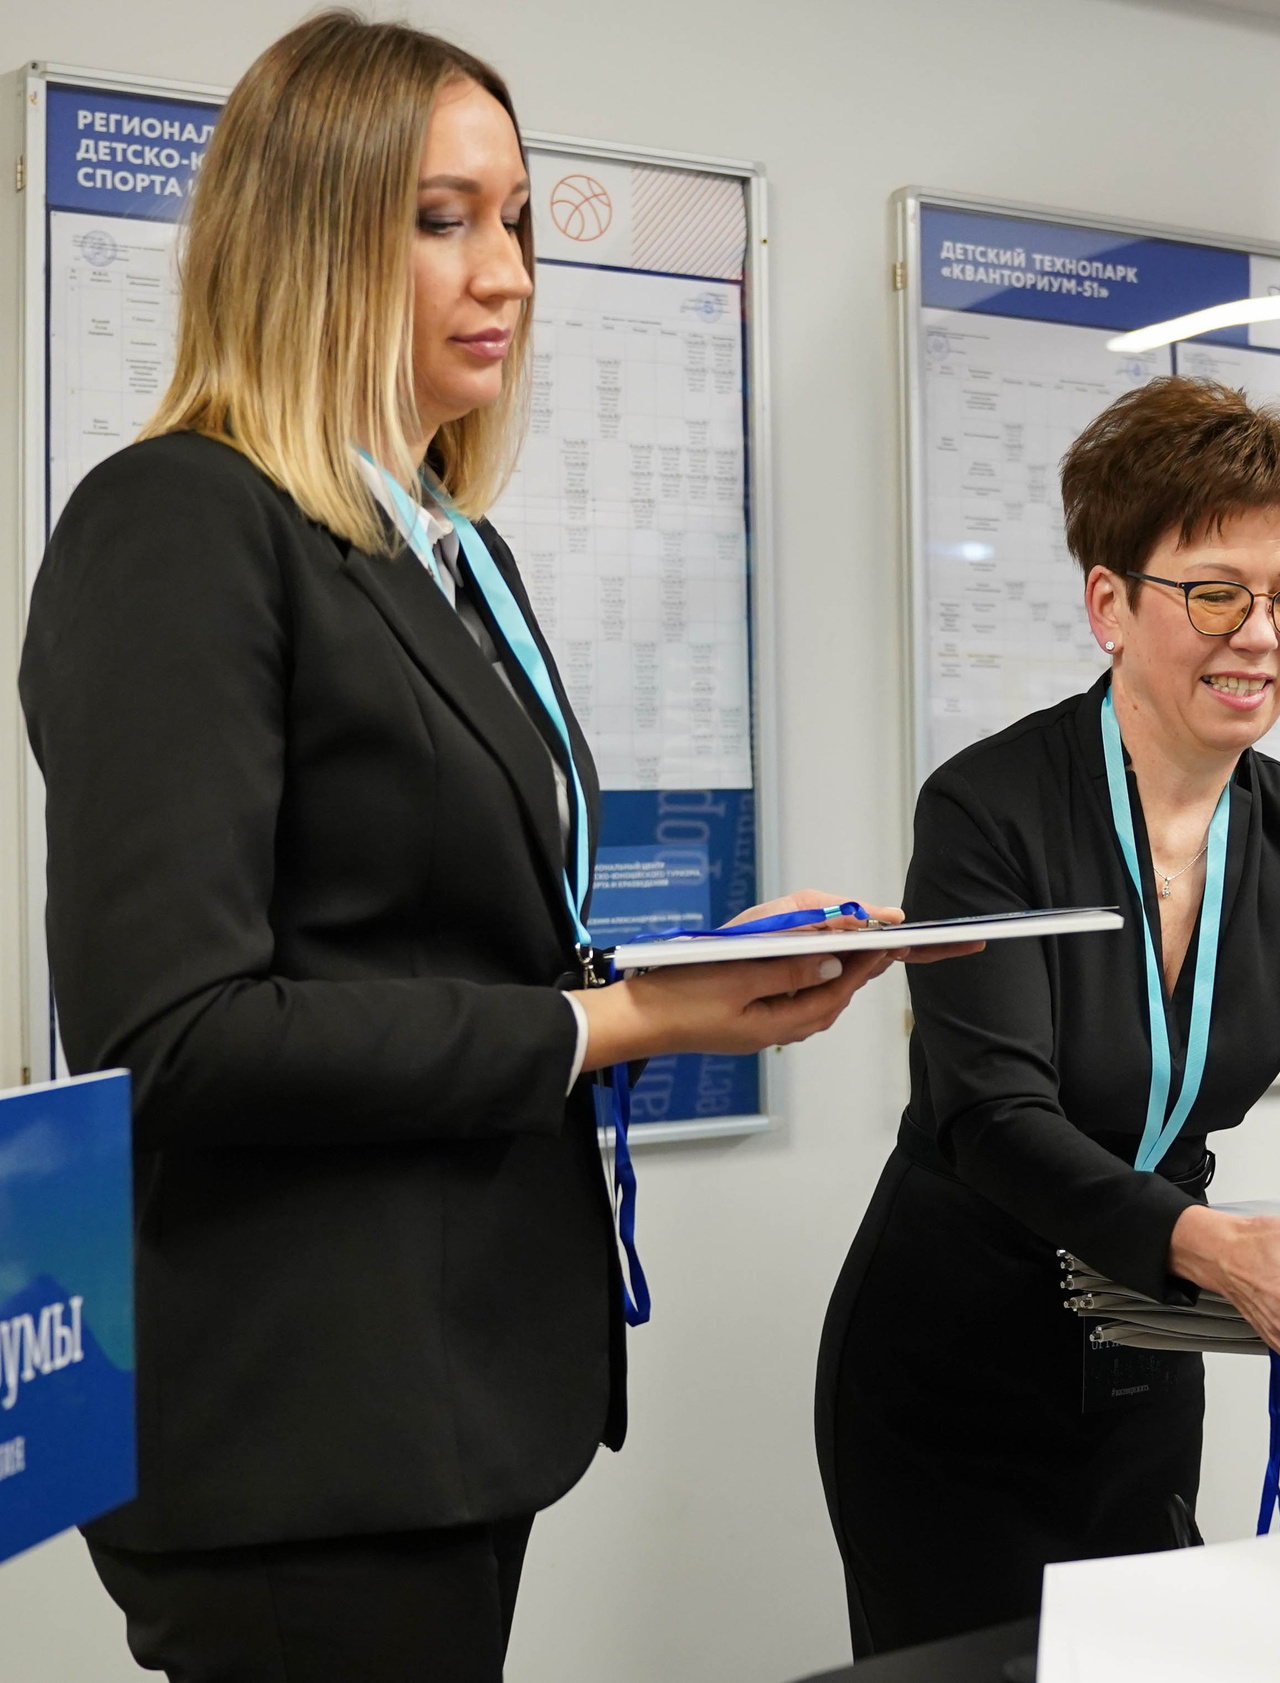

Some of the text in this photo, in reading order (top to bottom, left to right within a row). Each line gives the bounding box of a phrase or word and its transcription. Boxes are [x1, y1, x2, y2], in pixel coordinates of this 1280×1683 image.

[77, 167, 183, 198] СПОРТА
[940, 240, 1138, 283] ДЕТСКИЙ ТЕХНОПАРК
[940, 263, 1109, 299] «КВАНТОРИУМ-51»
[0, 1295, 84, 1410] умы
